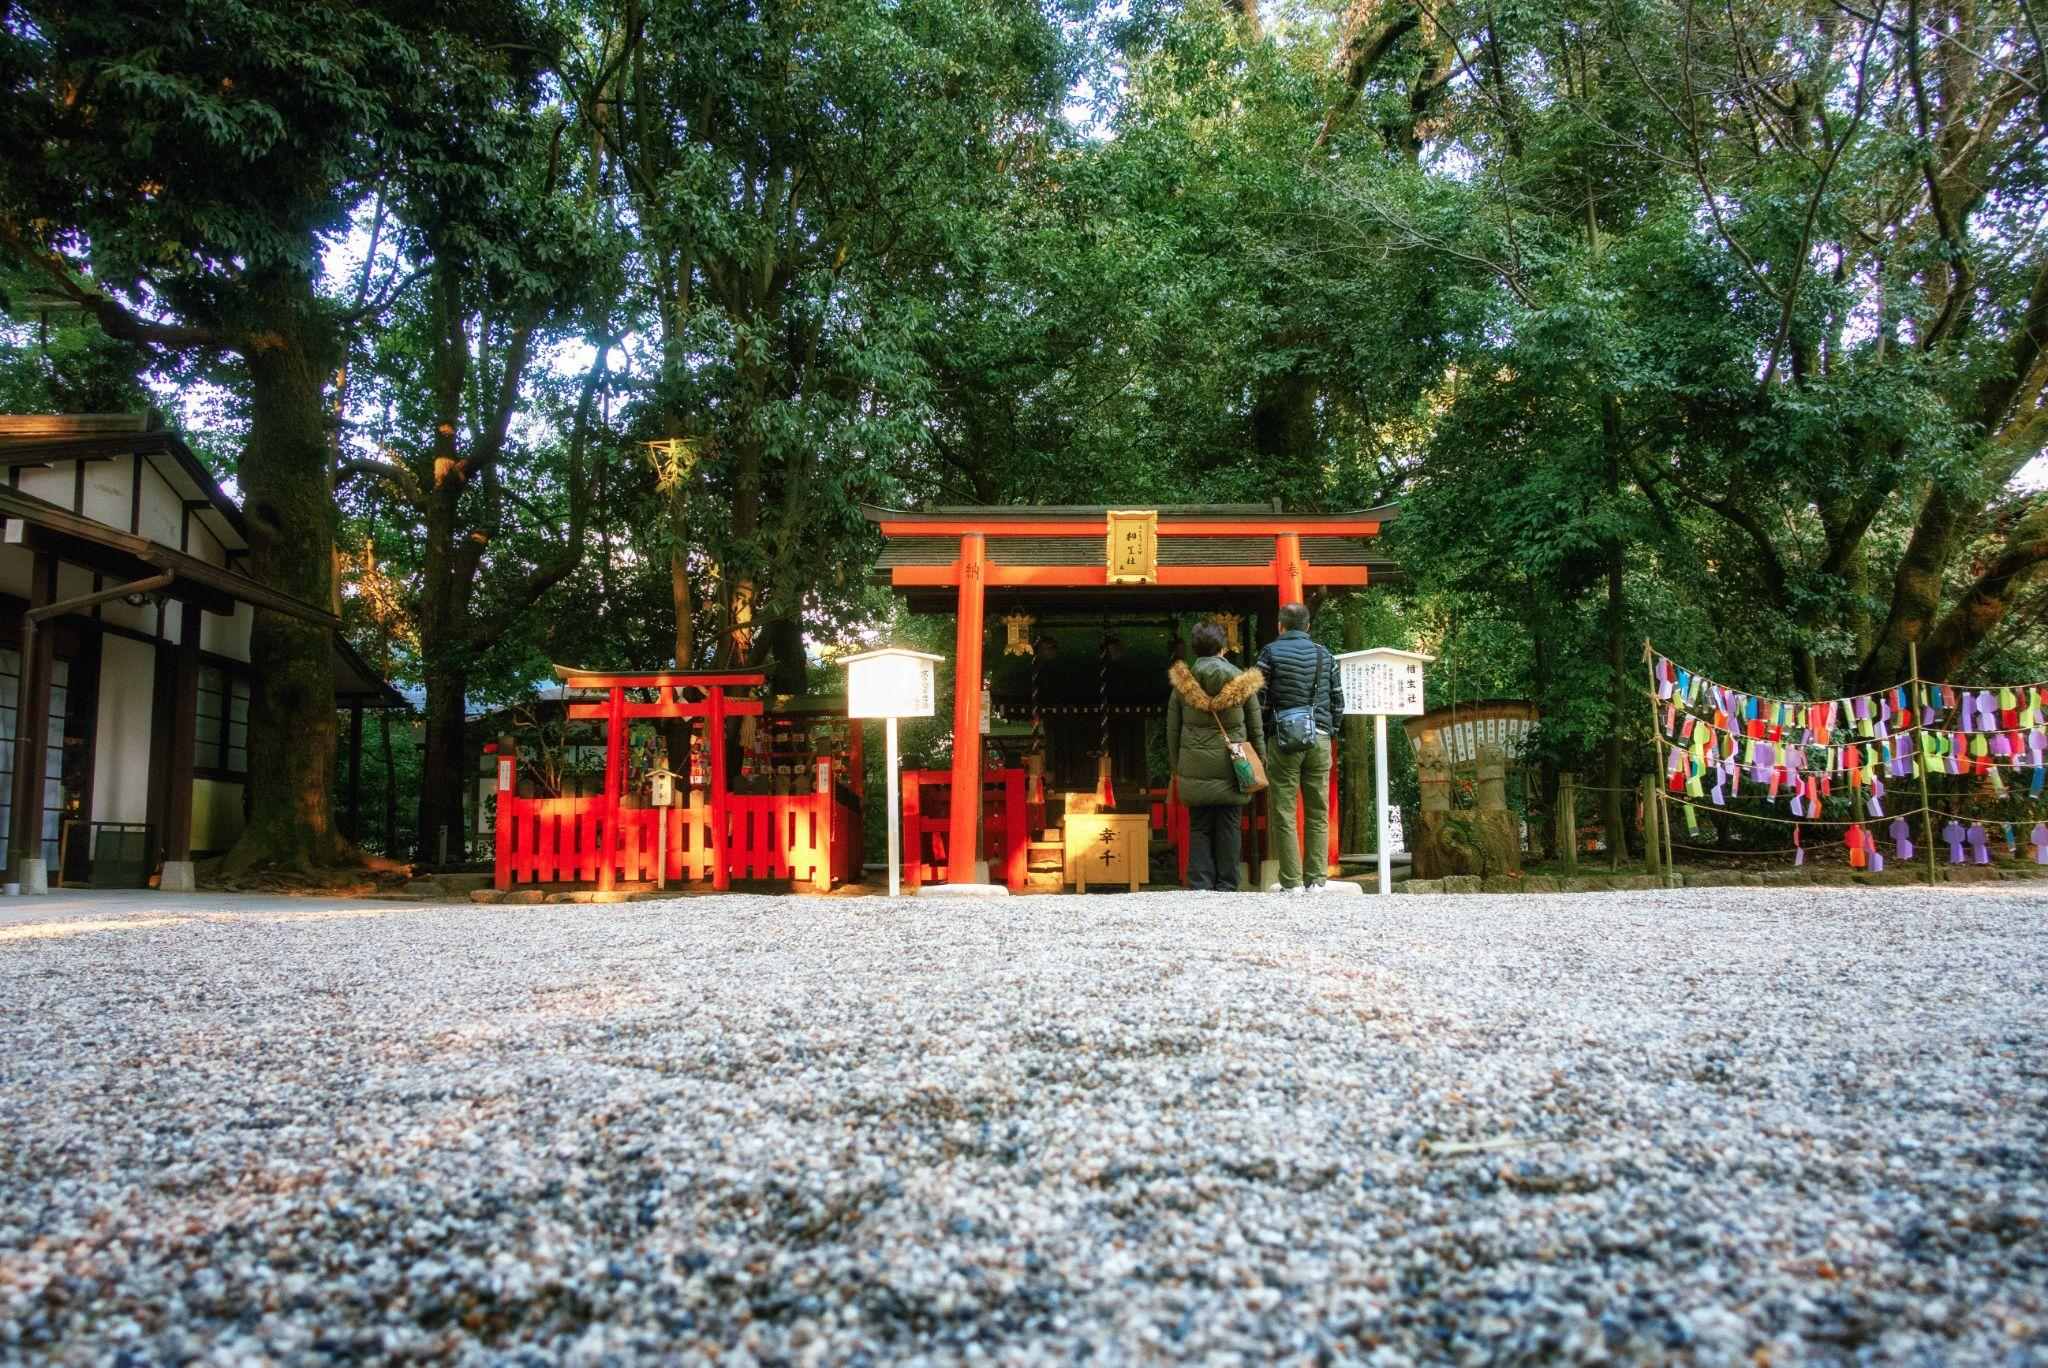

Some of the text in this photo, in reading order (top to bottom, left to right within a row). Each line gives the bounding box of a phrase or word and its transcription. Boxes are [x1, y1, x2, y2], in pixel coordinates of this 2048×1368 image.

[1127, 532, 1136, 565] 相生社
[966, 563, 980, 580] 納
[1286, 562, 1299, 579] 奉
[1407, 664, 1416, 703] 相生社
[1099, 828, 1116, 866] 幸千
